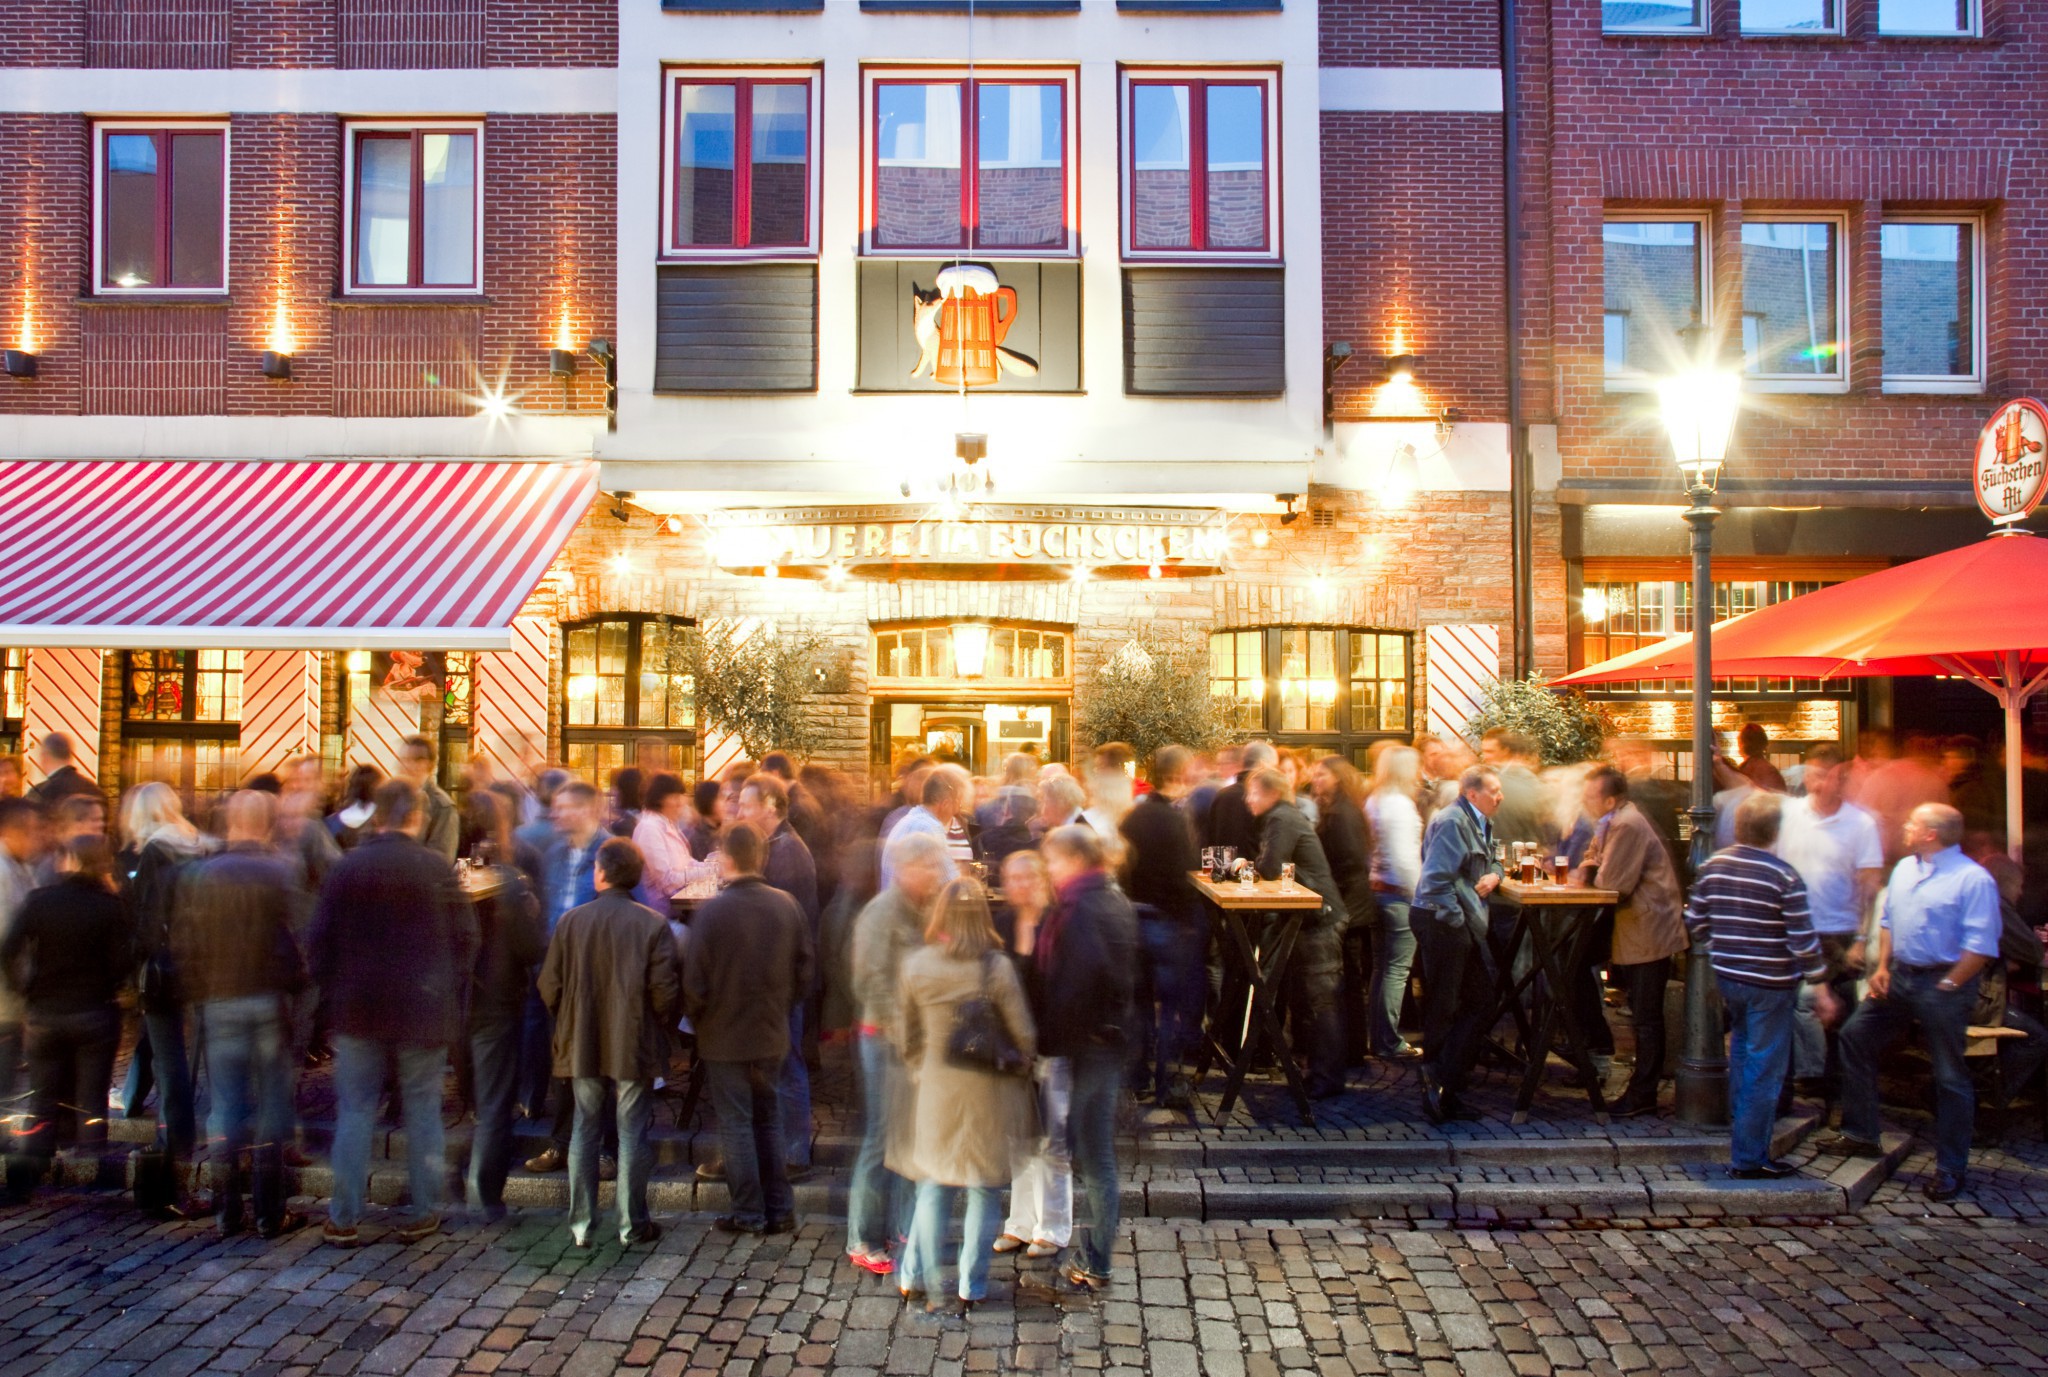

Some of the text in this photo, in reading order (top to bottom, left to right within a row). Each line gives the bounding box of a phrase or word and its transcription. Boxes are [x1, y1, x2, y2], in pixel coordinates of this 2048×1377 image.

[1981, 460, 2043, 492] Füchschen
[2002, 486, 2022, 511] Alt
[940, 524, 981, 556] IM
